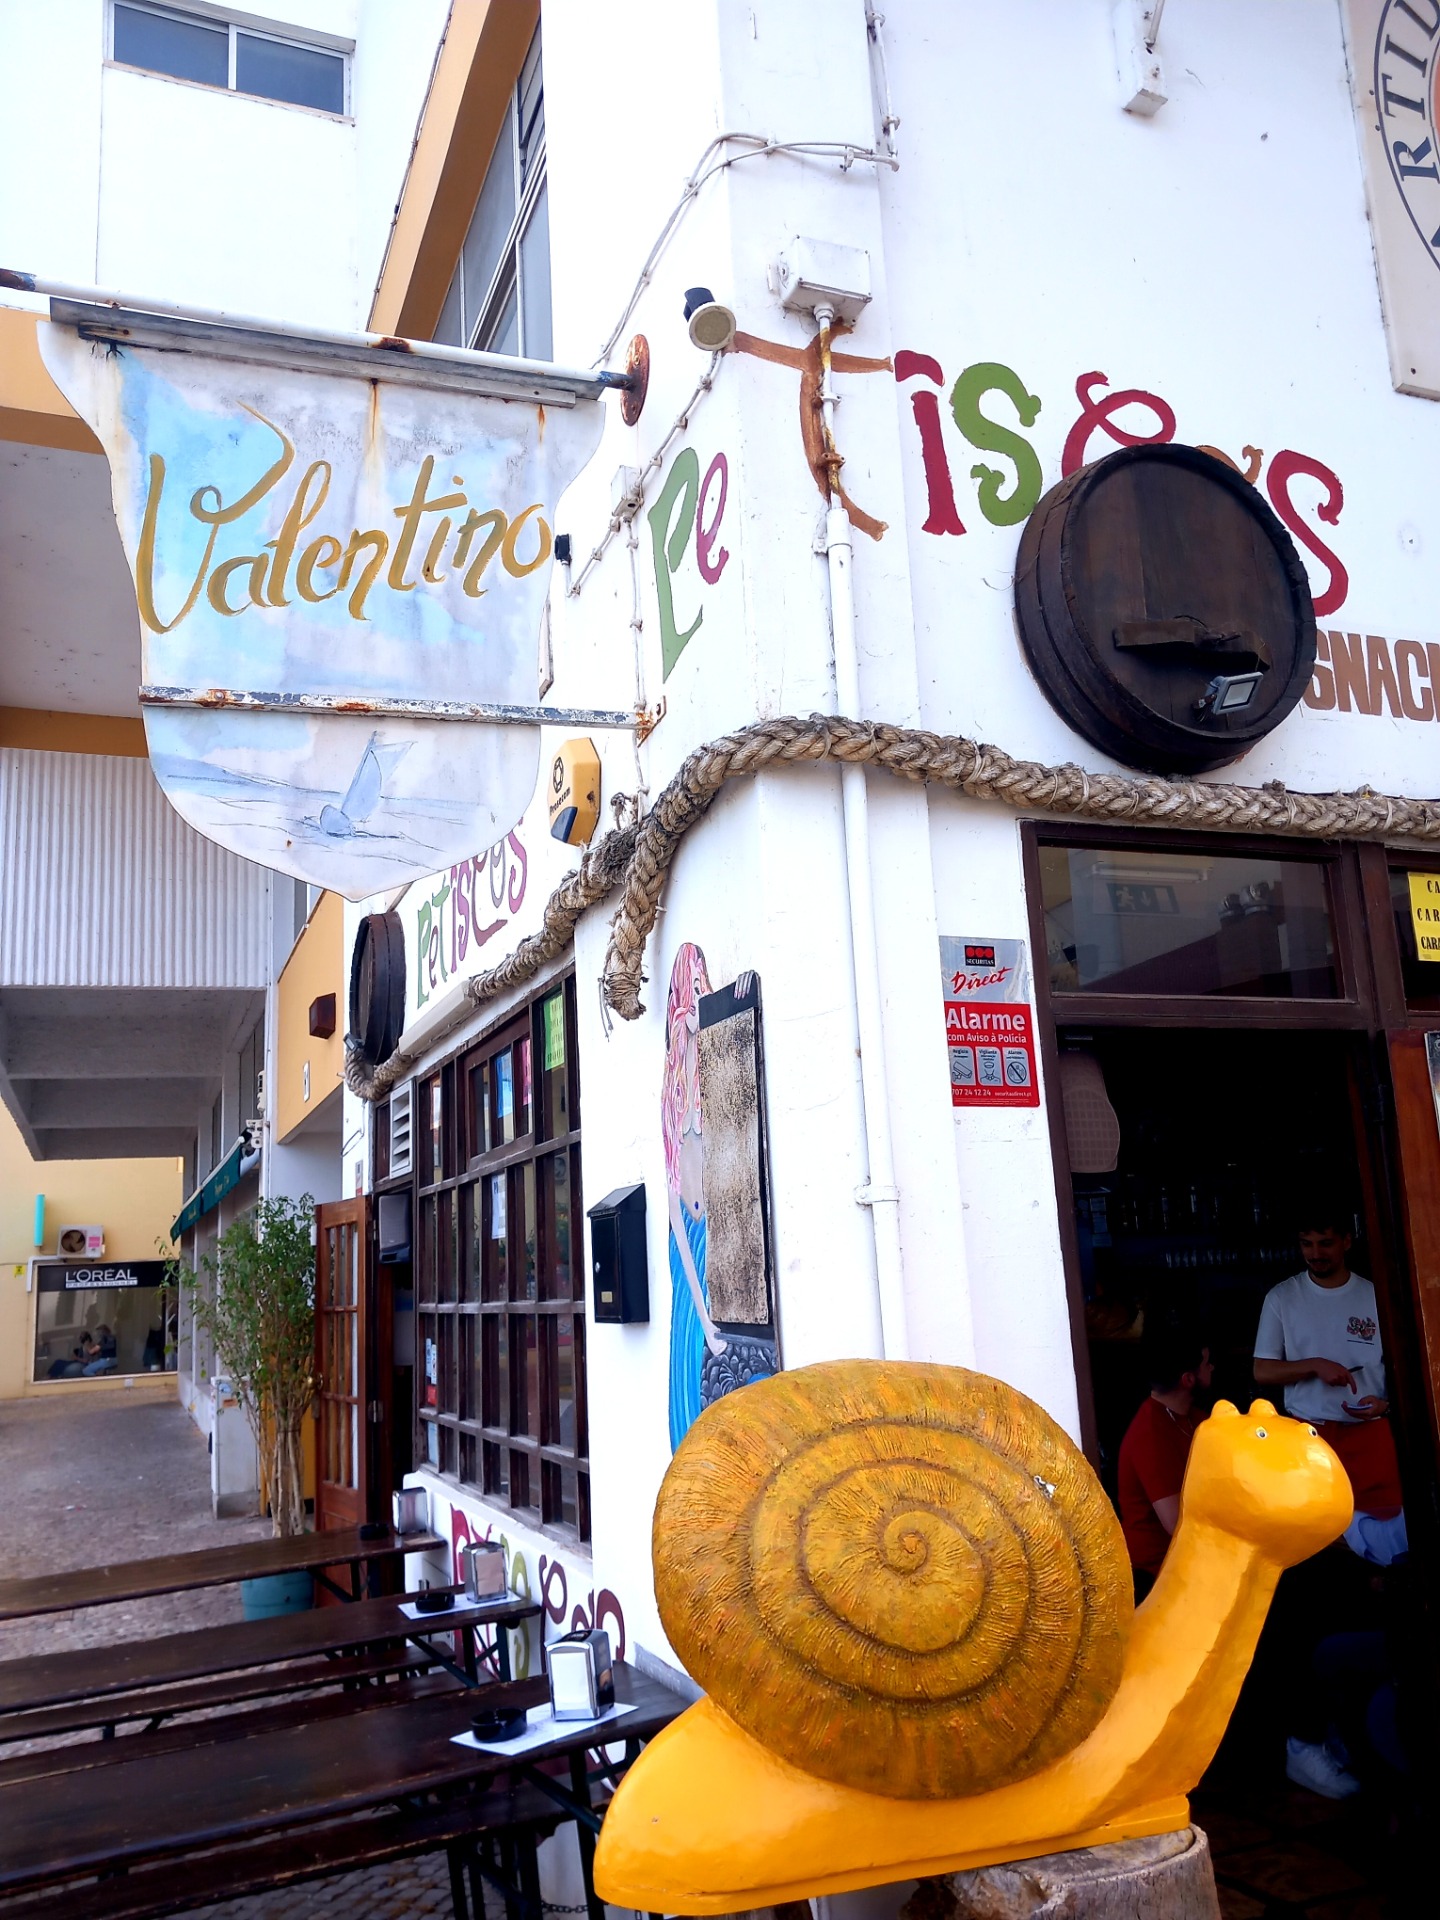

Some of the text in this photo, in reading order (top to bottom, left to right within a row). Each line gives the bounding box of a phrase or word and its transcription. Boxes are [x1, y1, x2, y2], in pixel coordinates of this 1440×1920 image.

[136, 398, 552, 635] Valentino
[951, 966, 1013, 995] Direct
[946, 1007, 1025, 1031] Alarme
[947, 1033, 965, 1041] com
[966, 1032, 989, 1042] Aviso
